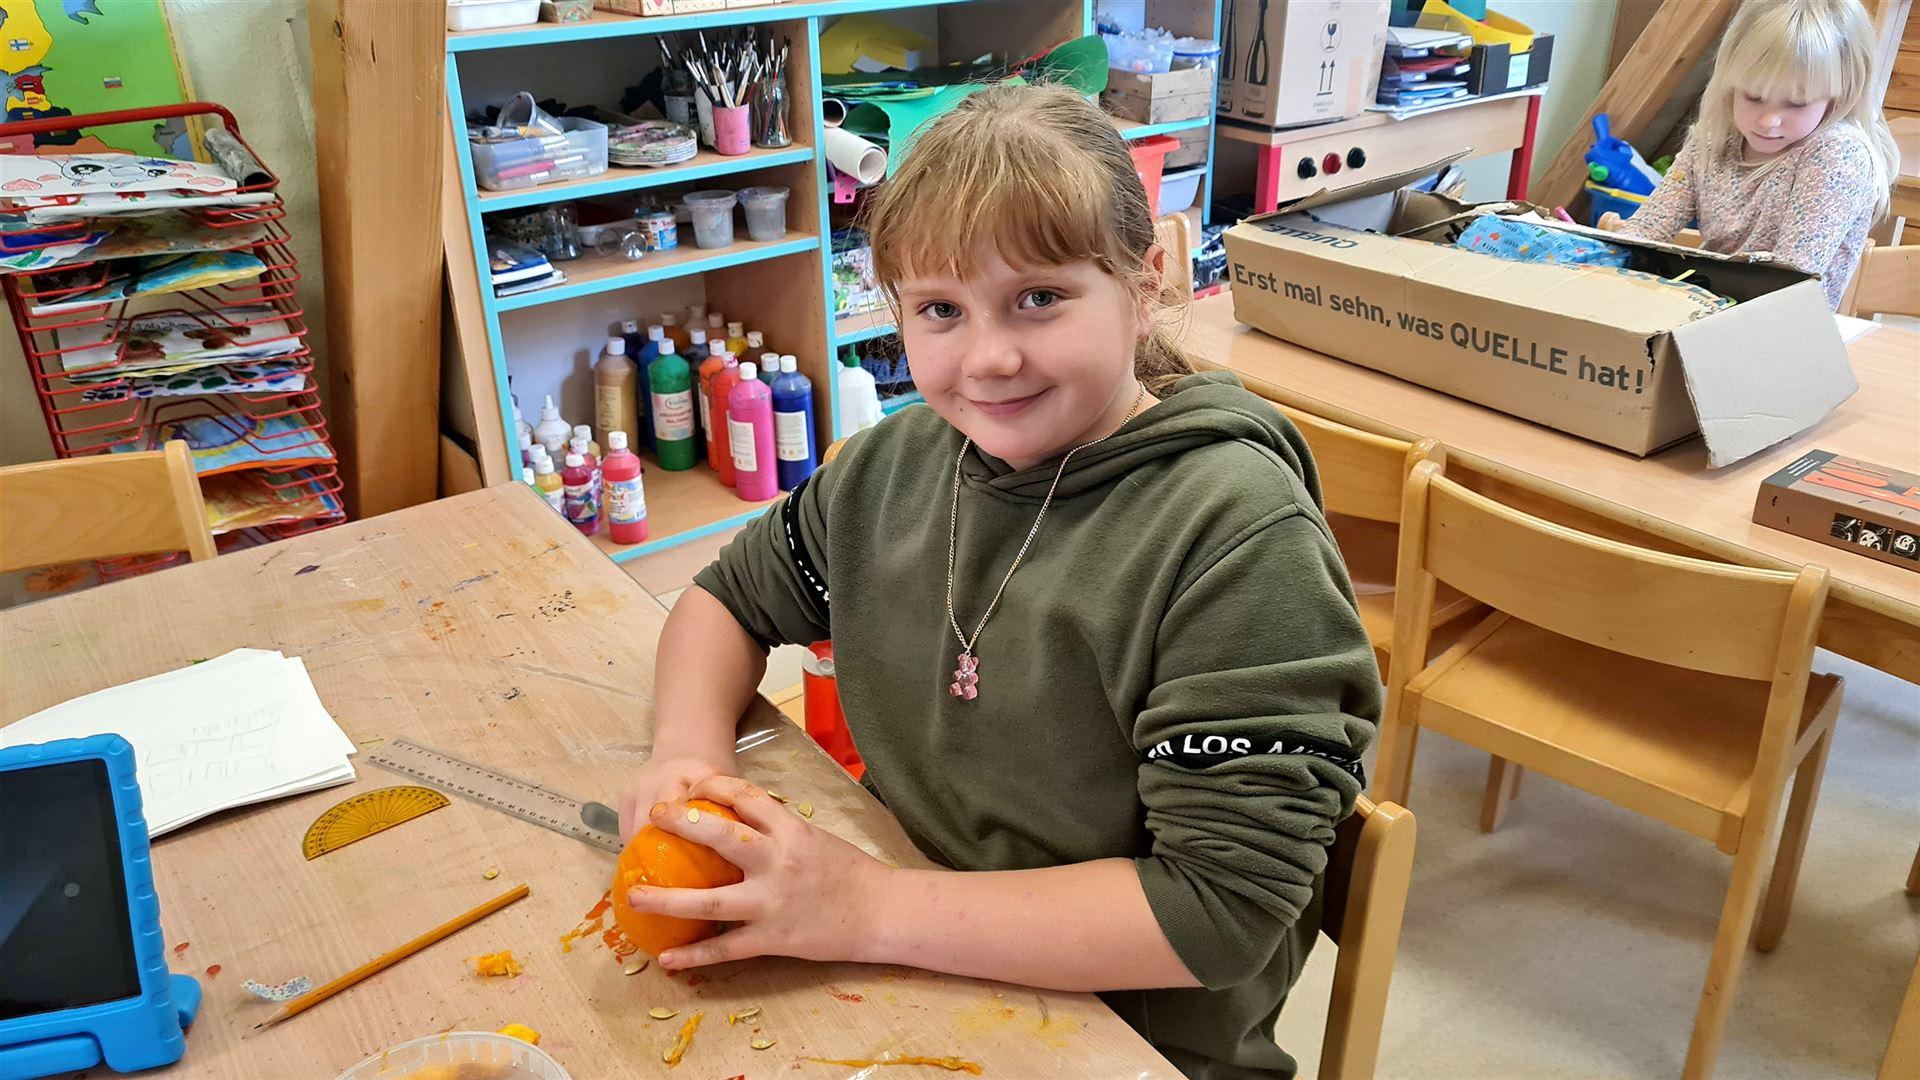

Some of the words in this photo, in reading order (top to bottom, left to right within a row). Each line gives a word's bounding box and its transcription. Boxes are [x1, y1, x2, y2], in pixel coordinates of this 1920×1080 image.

[1233, 263, 1278, 293] Erst
[1284, 281, 1322, 306] mal
[1329, 293, 1392, 328] sehn,
[1397, 311, 1445, 341] was
[1450, 322, 1568, 376] QUELLE
[1183, 734, 1251, 755] LOS
